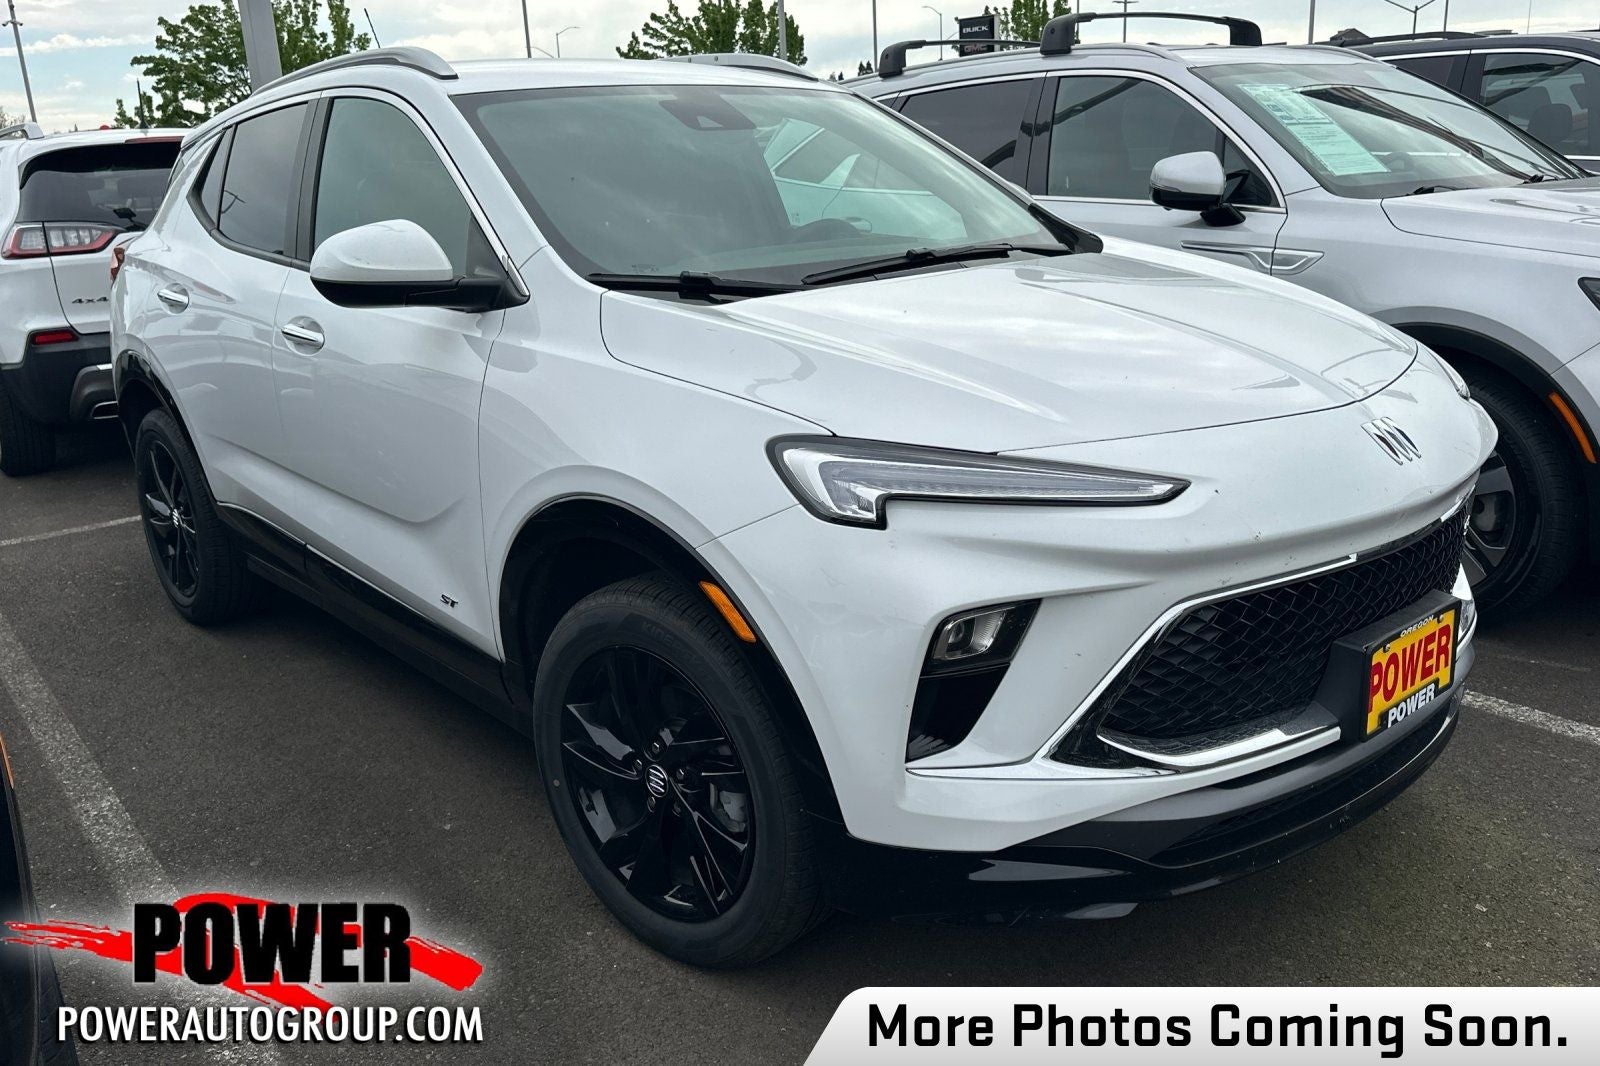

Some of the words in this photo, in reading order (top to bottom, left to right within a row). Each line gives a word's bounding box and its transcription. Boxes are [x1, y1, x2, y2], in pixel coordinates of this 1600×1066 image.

[962, 25, 989, 34] BUICK
[964, 43, 988, 53] GMC
[440, 594, 459, 608] ST
[1400, 615, 1434, 637] OREGON
[1367, 623, 1451, 714] POWER
[1387, 683, 1435, 729] POWER
